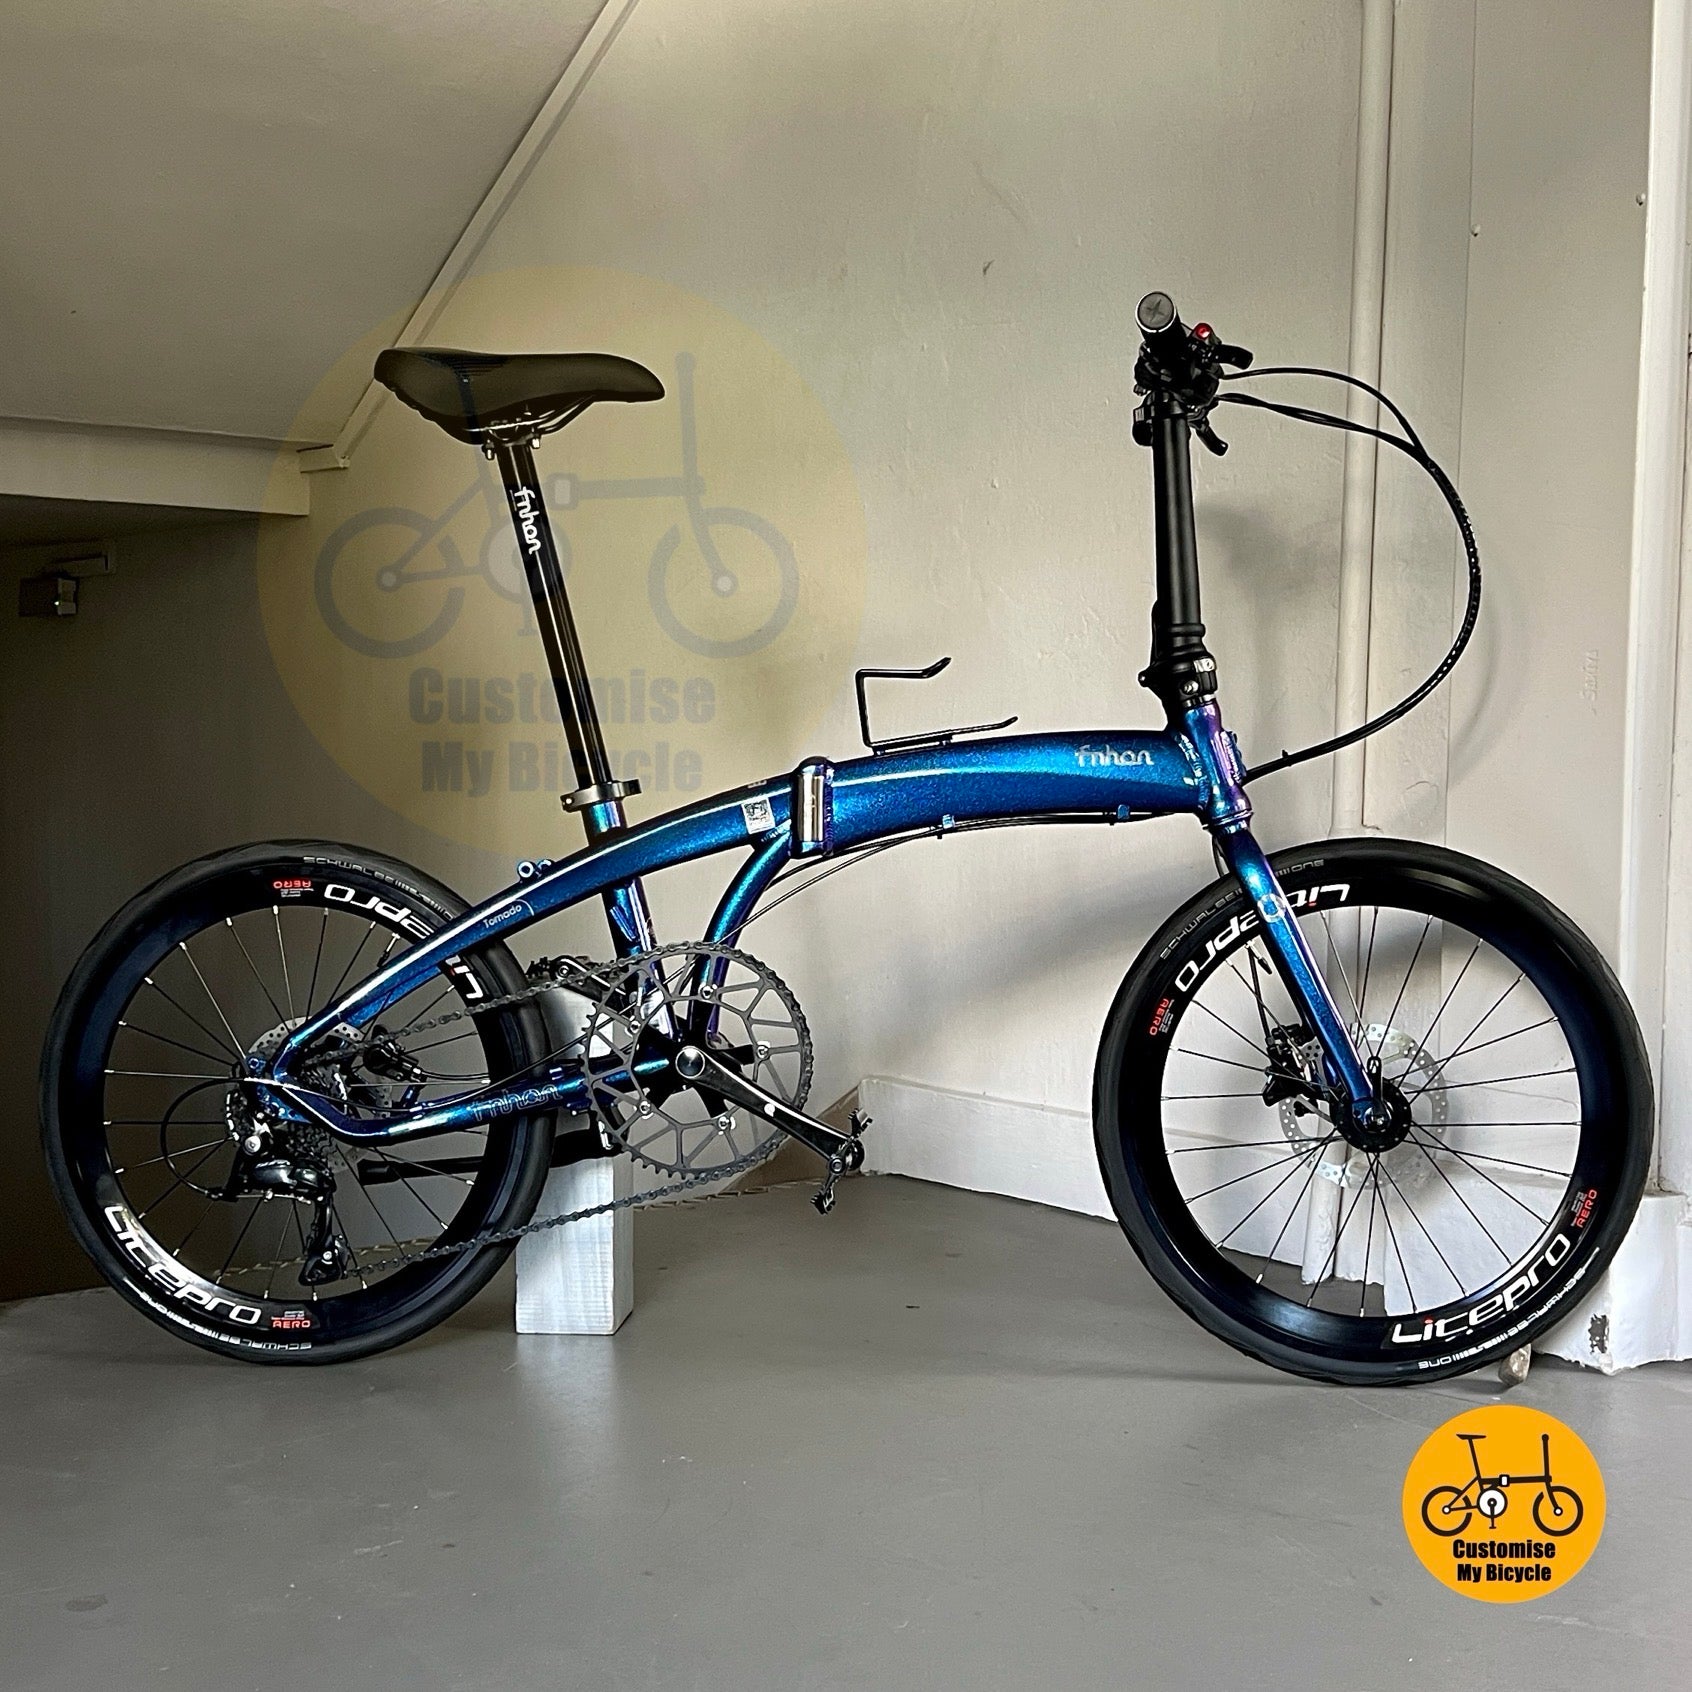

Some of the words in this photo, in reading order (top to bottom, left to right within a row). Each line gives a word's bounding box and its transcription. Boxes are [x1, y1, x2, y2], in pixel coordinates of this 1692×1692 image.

[514, 486, 541, 555] fnhon
[1074, 744, 1154, 767] fnhon
[273, 880, 312, 889] AERO
[1160, 893, 1236, 960] SCHWALBE
[1149, 998, 1170, 1036] AERO
[1576, 1189, 1598, 1228] AERO
[1391, 1233, 1571, 1343] Litepro
[272, 1320, 311, 1329] AERO
